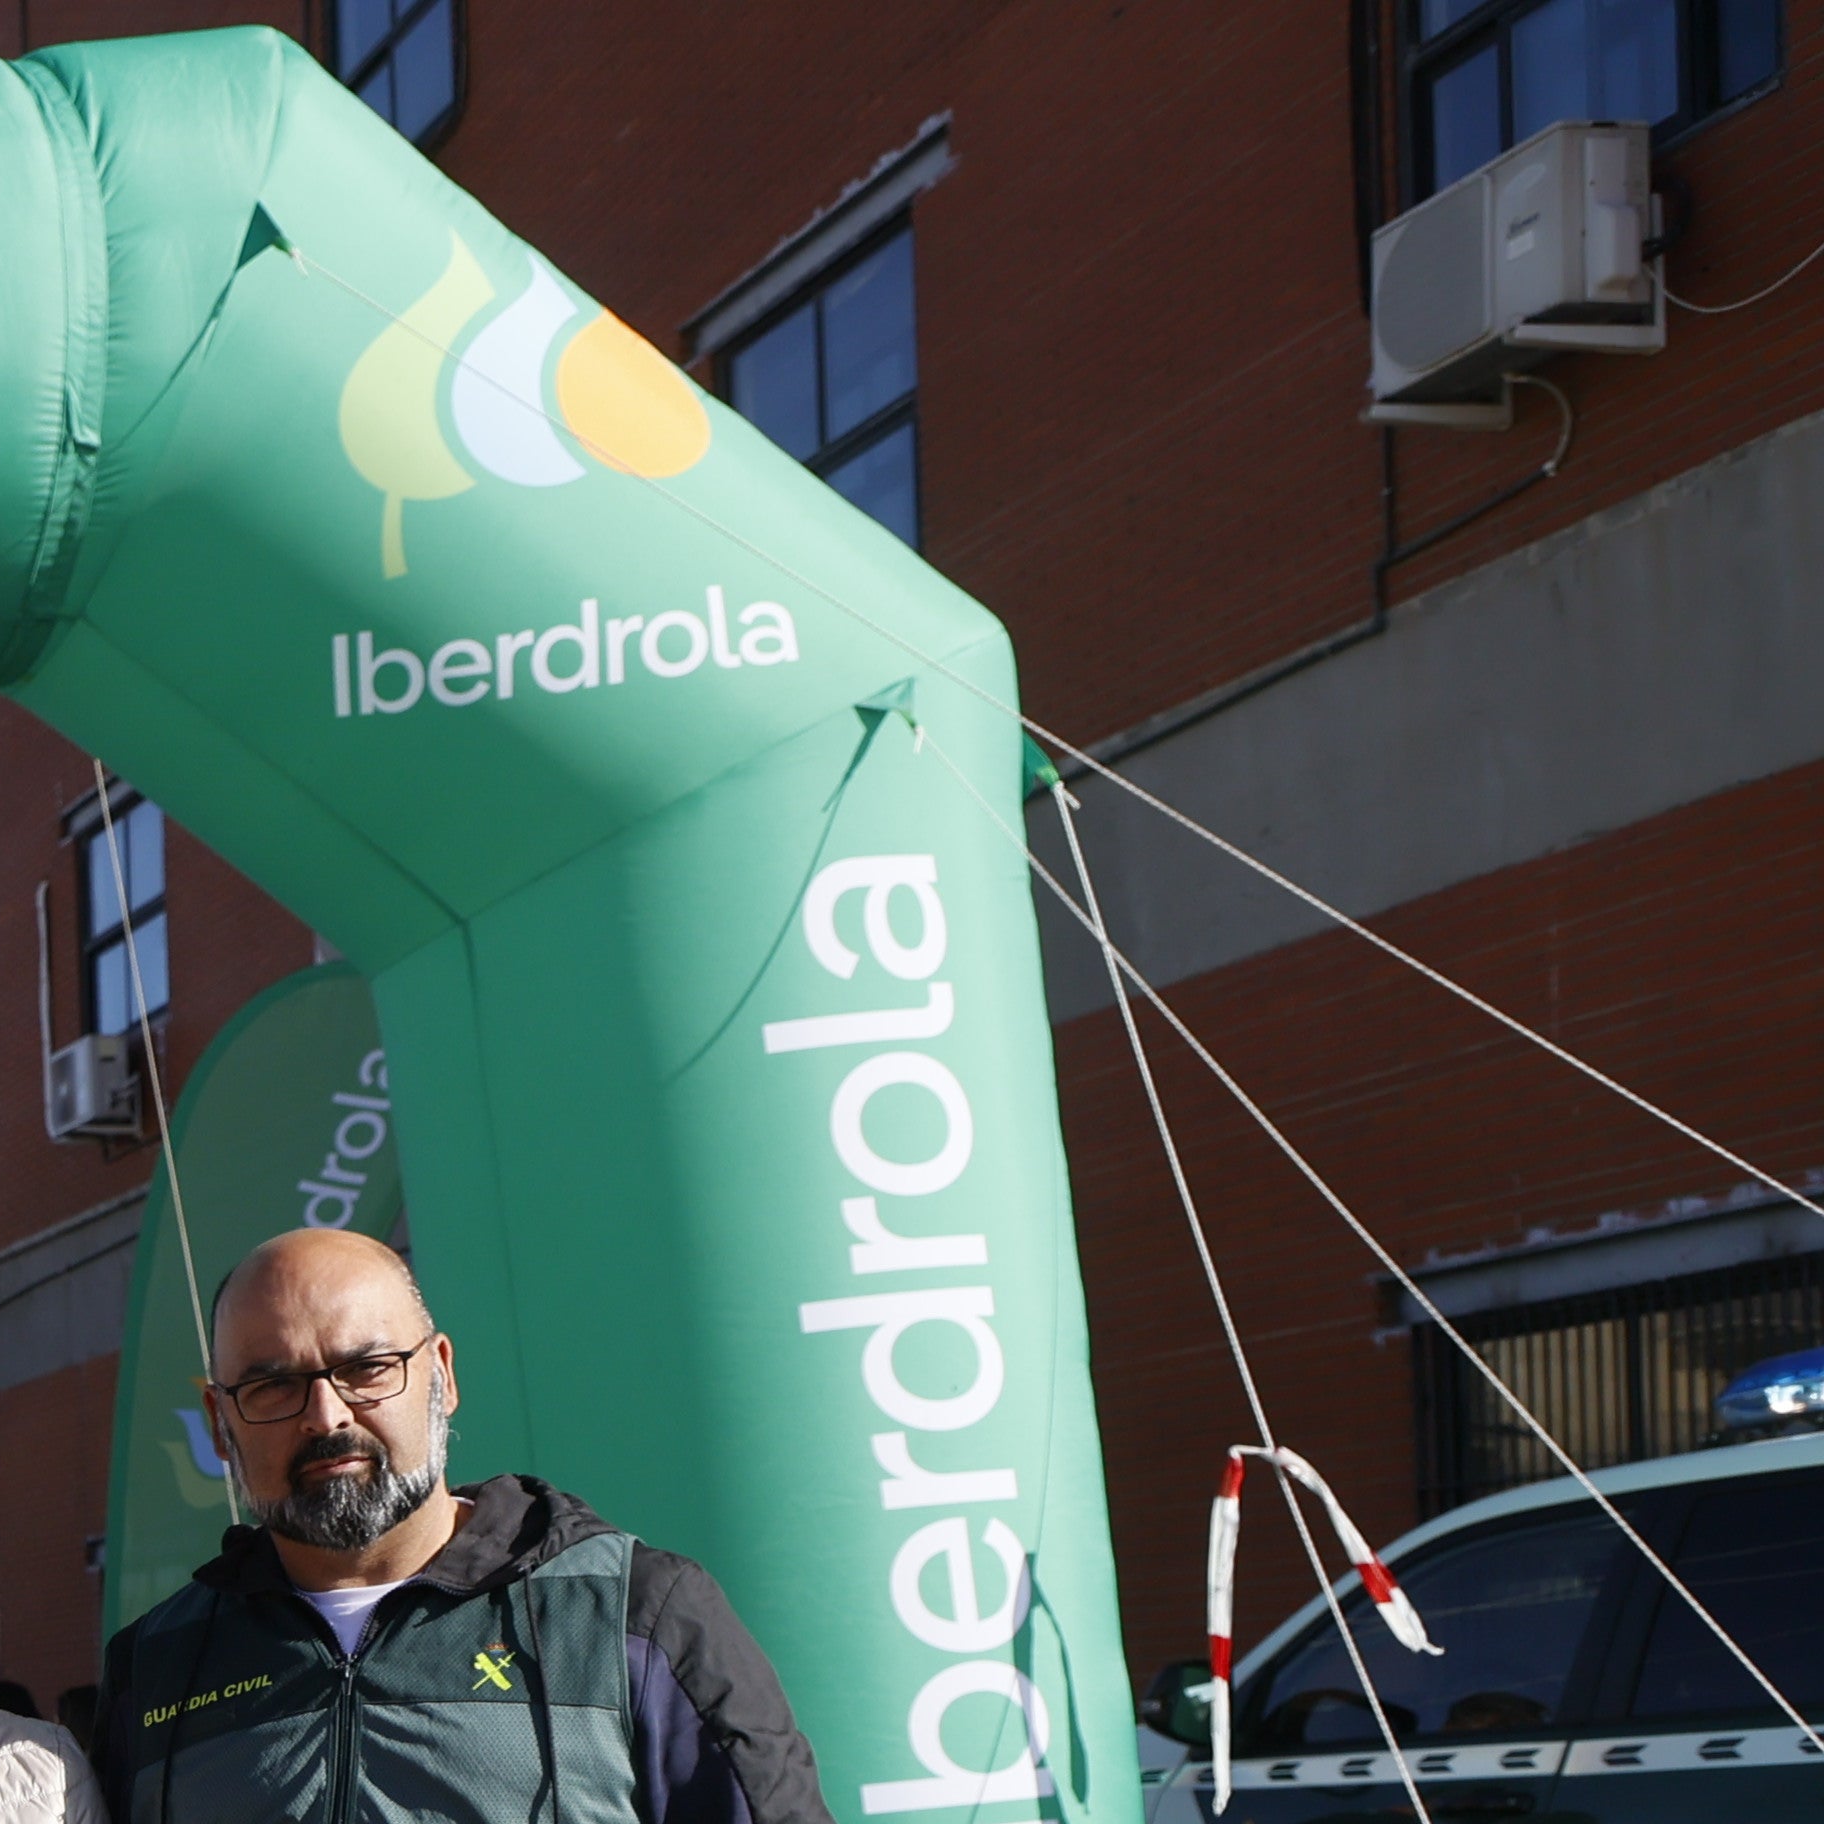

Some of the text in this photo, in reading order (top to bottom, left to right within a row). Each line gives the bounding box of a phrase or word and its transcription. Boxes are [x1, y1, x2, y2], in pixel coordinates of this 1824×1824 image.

[330, 586, 799, 717] Iberdrola
[297, 1049, 392, 1229] drola
[223, 1674, 273, 1698] CIVIL
